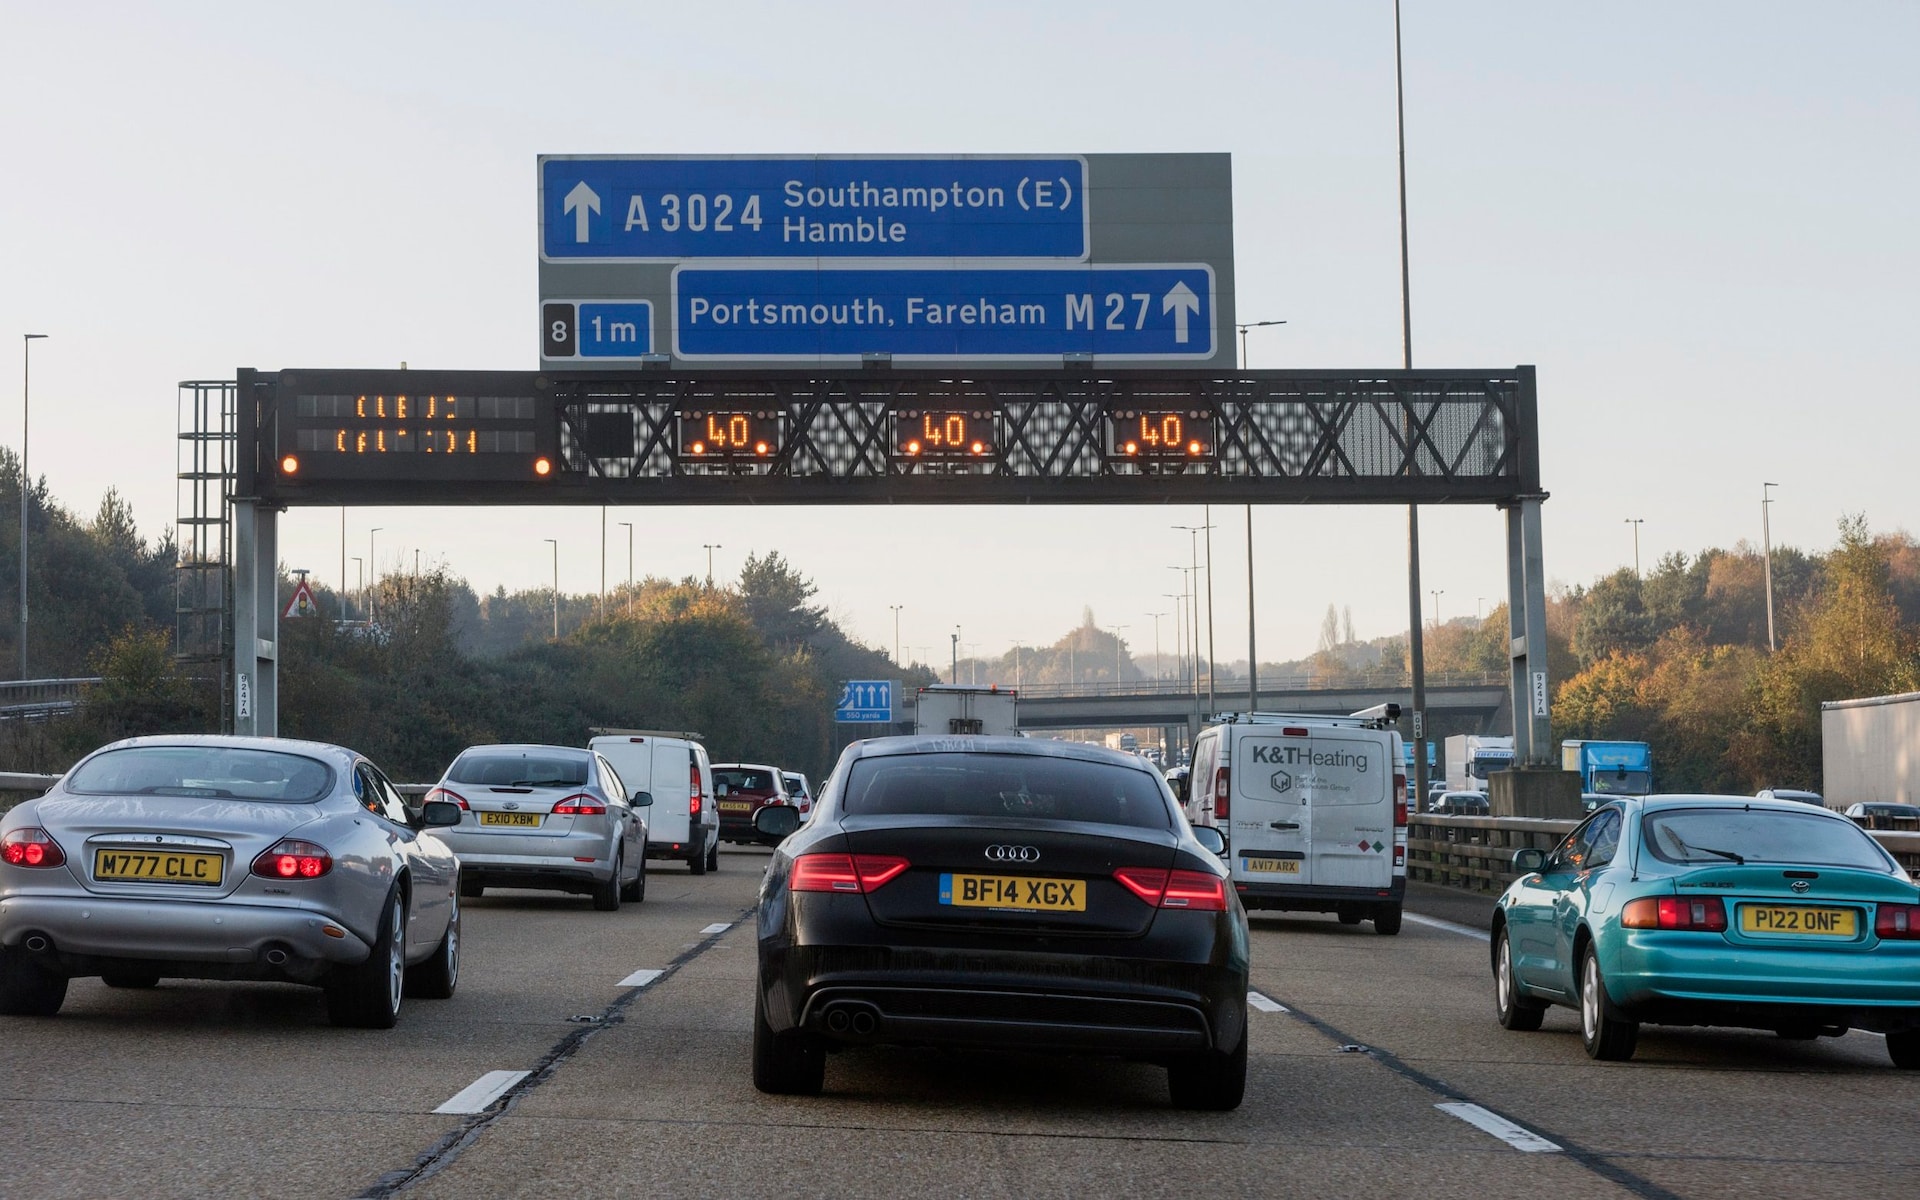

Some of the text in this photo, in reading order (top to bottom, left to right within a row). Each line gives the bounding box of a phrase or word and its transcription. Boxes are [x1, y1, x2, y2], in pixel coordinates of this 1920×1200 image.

[783, 176, 1073, 213] Southampton (E)
[624, 194, 763, 232] A 3024
[783, 216, 907, 244] Hamble
[690, 294, 1151, 331] Portsmouth, Fareham M 27
[551, 320, 568, 343] 8
[707, 415, 747, 446] 40
[925, 415, 964, 446] 40
[1142, 415, 1181, 446] 40
[1536, 674, 1544, 714] 9247A
[862, 711, 881, 720] yards
[487, 813, 533, 825] EX10 XBM
[102, 854, 208, 878] M777 CLC
[1252, 860, 1295, 872] AV17 ARX
[963, 878, 1075, 906] BF14 XGX
[1755, 909, 1842, 931] P122 ONF
